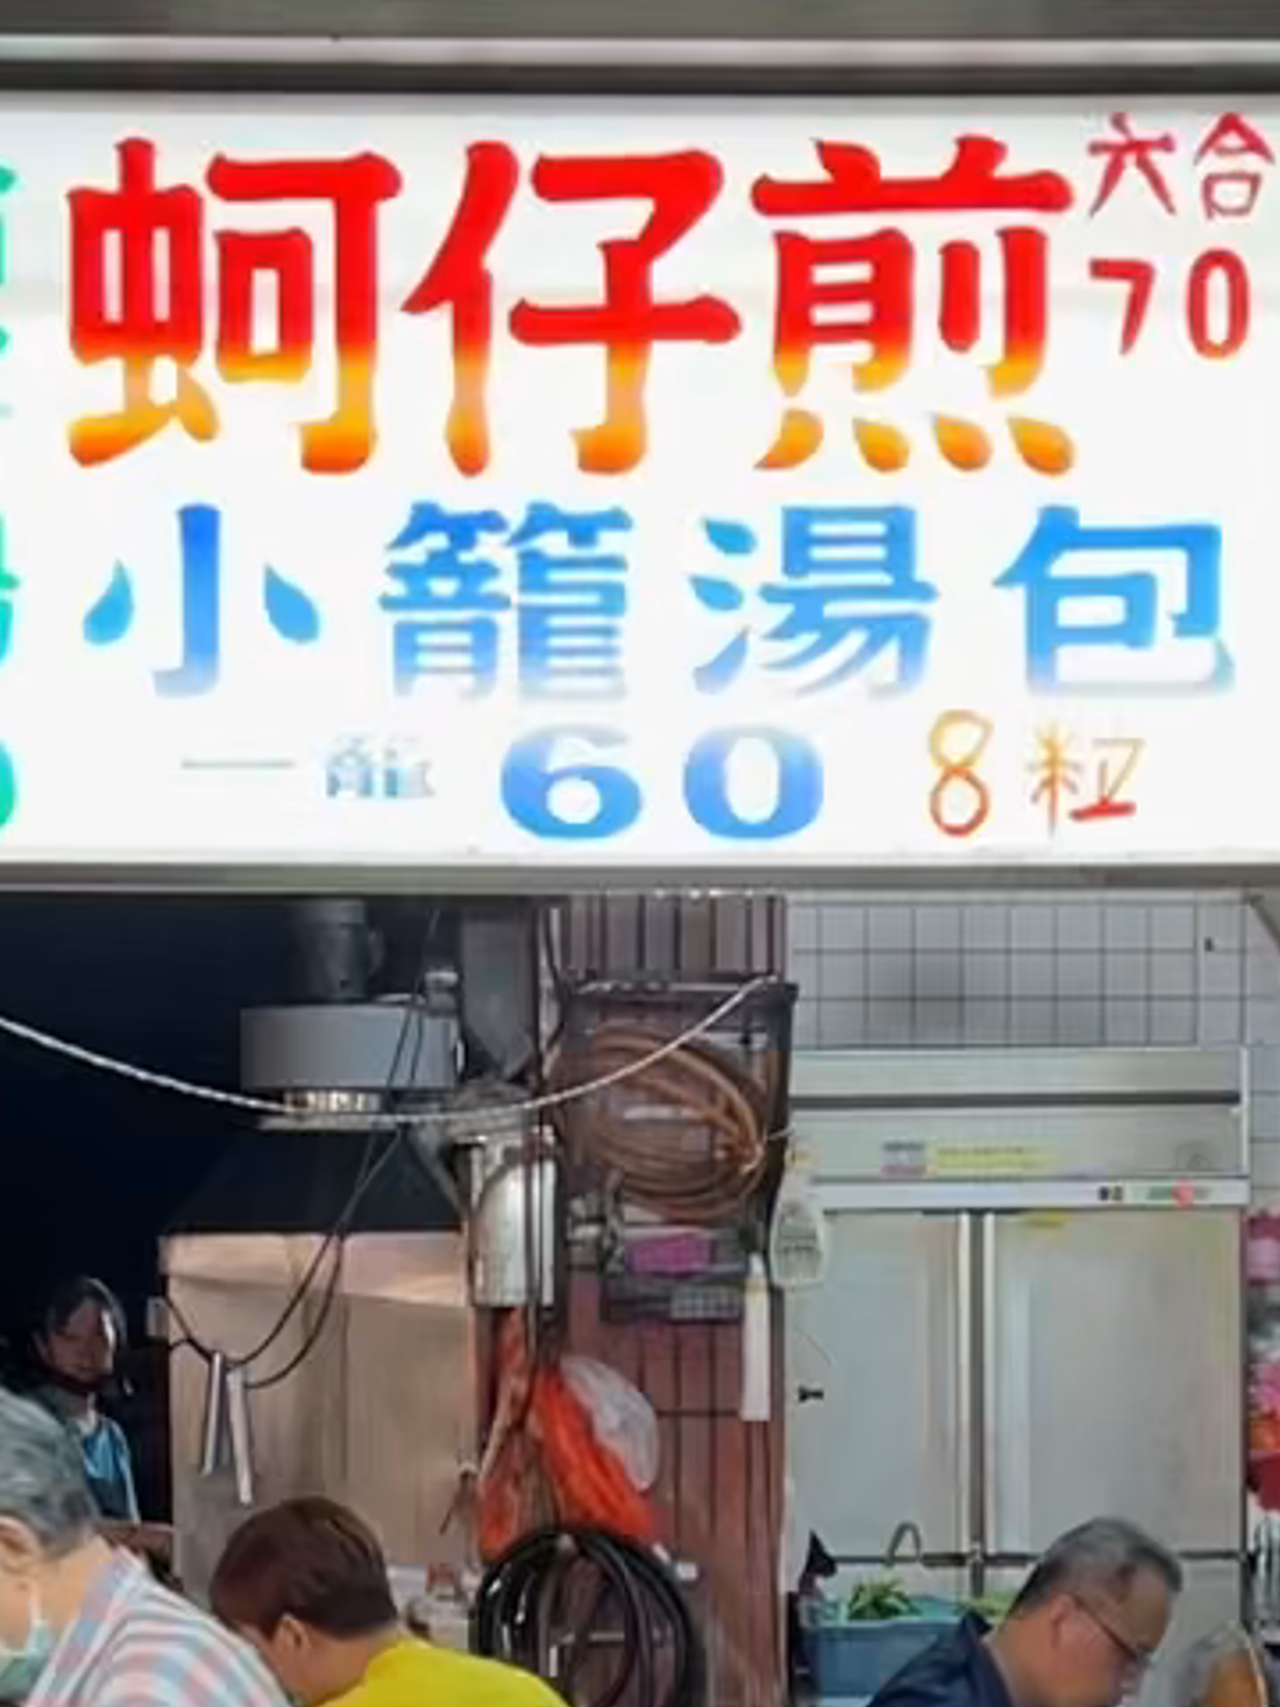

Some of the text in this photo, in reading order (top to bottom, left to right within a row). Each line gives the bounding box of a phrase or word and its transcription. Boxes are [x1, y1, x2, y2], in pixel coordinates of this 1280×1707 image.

[1086, 110, 1276, 221] 六合
[66, 134, 1078, 479] 蚵仔煎
[1086, 246, 1253, 362] 70
[81, 499, 1236, 698] 小籠湯包
[499, 724, 825, 842] 60
